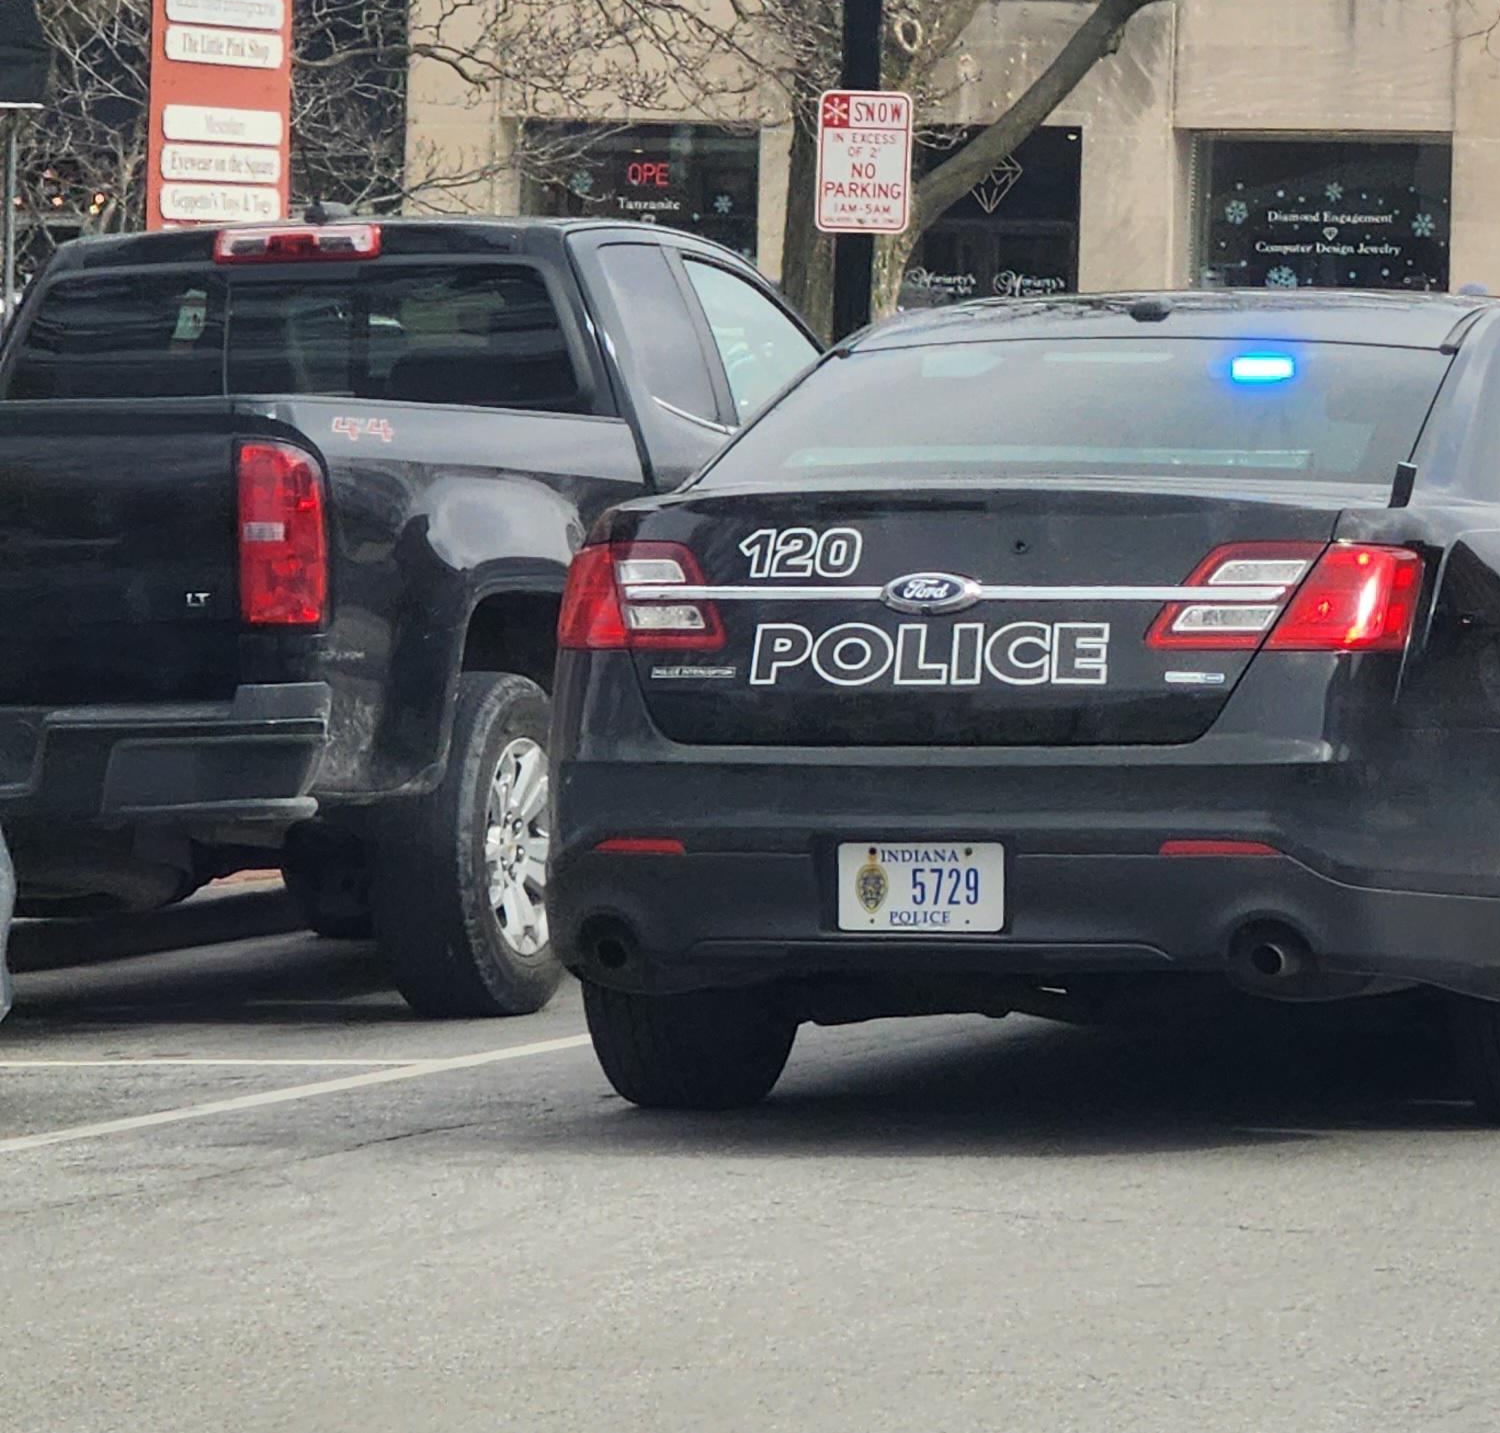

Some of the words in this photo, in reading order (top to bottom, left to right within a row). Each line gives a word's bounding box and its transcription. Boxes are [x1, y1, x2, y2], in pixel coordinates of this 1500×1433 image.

[854, 102, 903, 122] SNOW
[832, 133, 844, 143] IN
[852, 133, 896, 144] EXCESS
[848, 147, 863, 158] OF
[851, 163, 876, 179] NO
[824, 182, 901, 200] PARKING
[617, 197, 680, 211] Tanzanite
[1267, 210, 1320, 224] Diamond
[1323, 211, 1393, 225] Engagement
[1256, 241, 1313, 255] Computer
[1316, 242, 1354, 256] Design
[1357, 243, 1401, 258] Jewelry
[739, 527, 863, 578] 120
[903, 579, 950, 599] Ford
[186, 593, 211, 607] LT
[749, 621, 1110, 686] POLICE
[881, 849, 959, 863] INDIANA
[912, 868, 979, 905] 5729
[889, 911, 950, 924] POLICE
